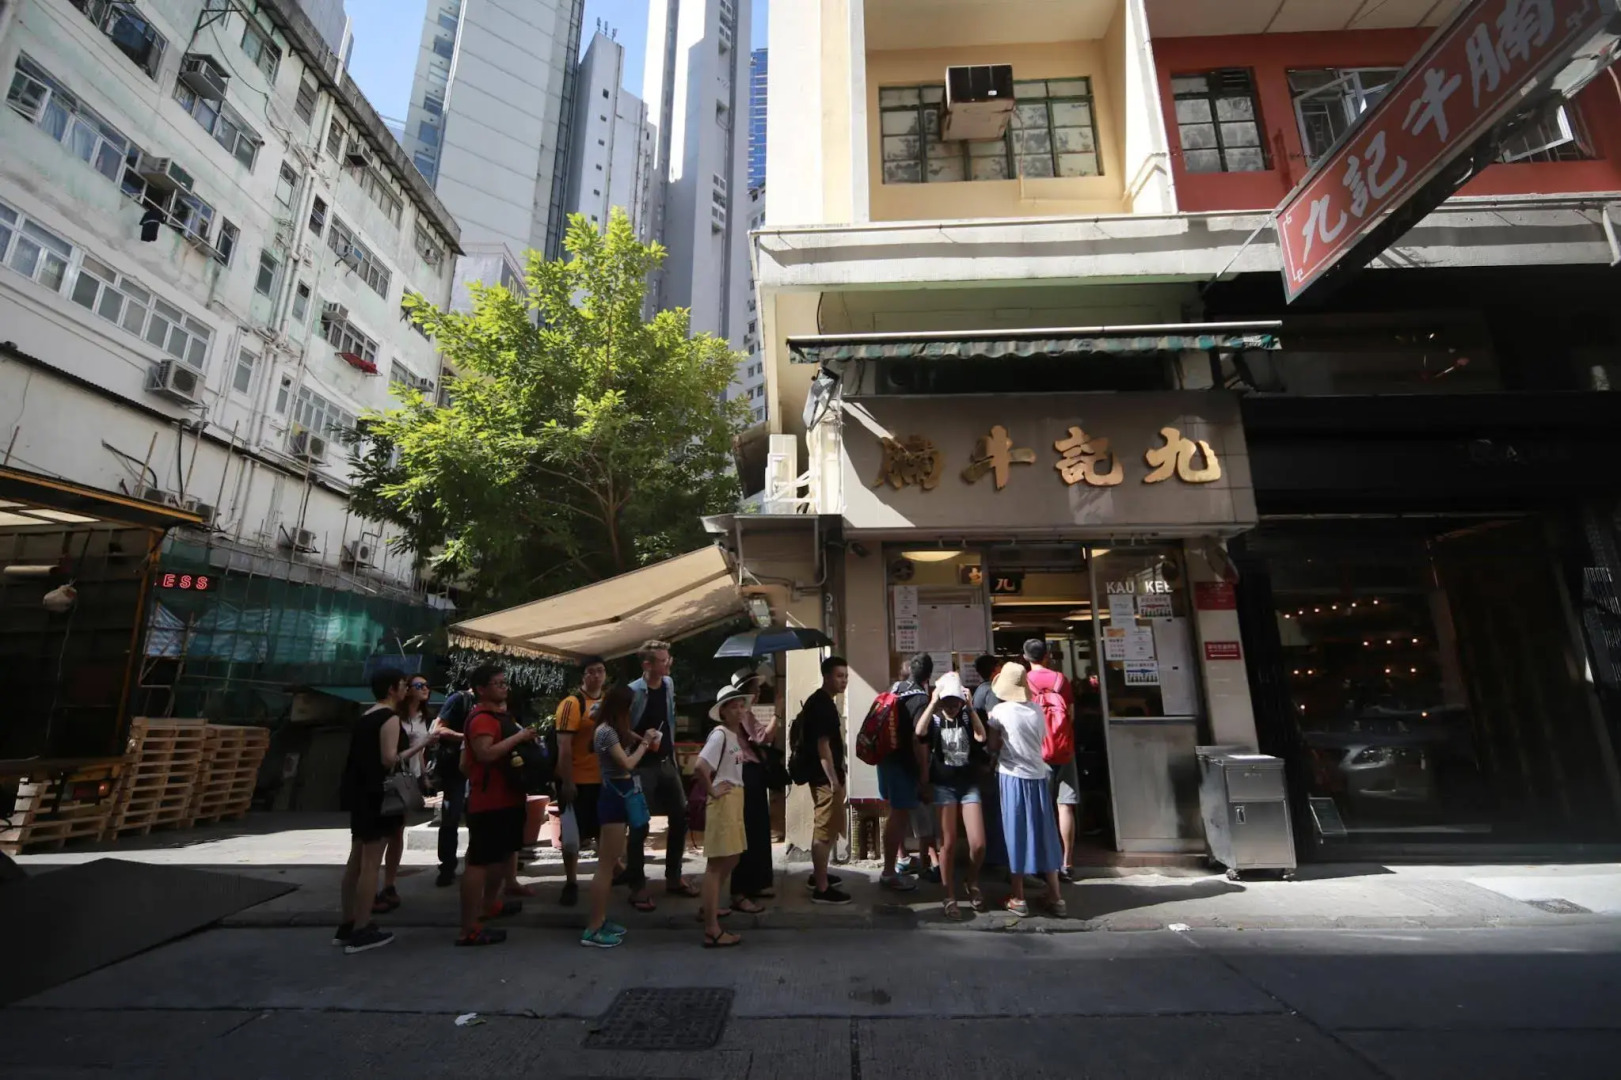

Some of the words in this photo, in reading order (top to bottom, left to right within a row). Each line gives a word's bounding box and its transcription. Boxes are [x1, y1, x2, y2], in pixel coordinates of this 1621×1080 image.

[1302, 0, 1555, 263] 九記牛腩
[1106, 581, 1135, 594] KAU
